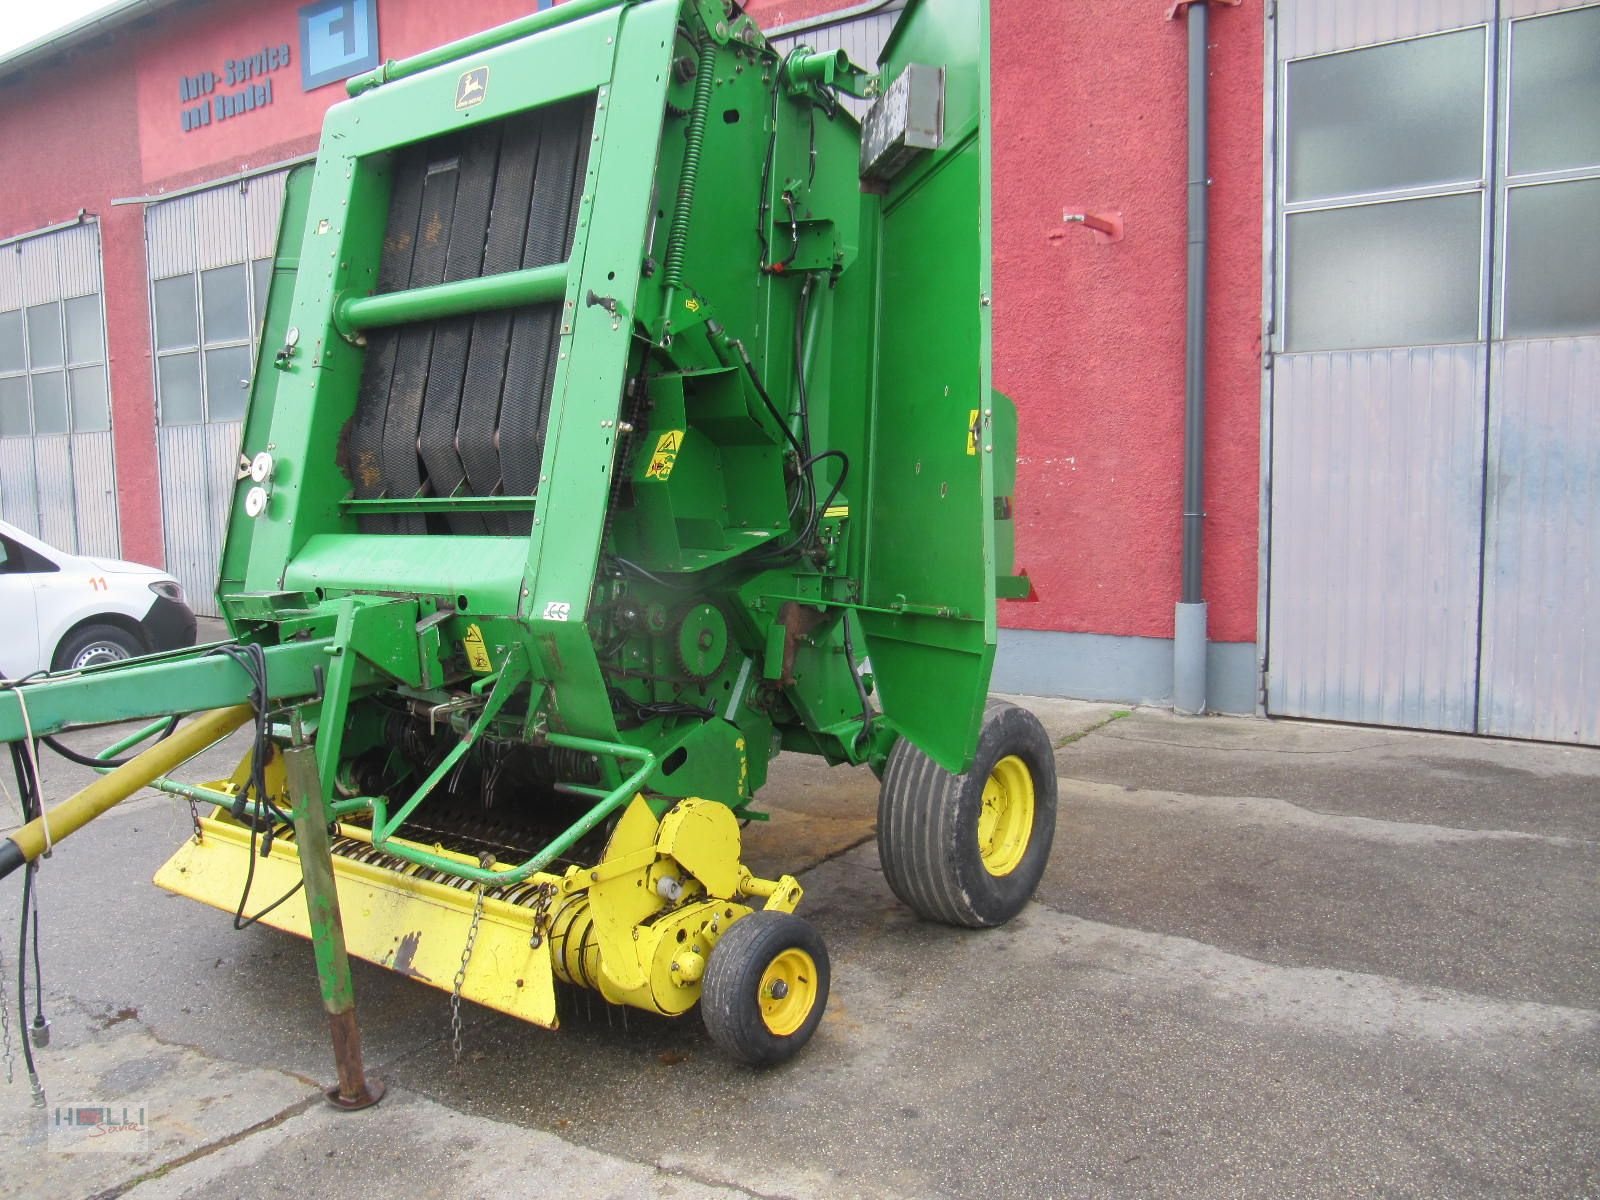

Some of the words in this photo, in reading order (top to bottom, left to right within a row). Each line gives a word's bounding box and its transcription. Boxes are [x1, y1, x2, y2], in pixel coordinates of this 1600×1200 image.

[181, 98, 211, 132] und
[214, 77, 273, 121] Handel
[89, 577, 107, 591] 11
